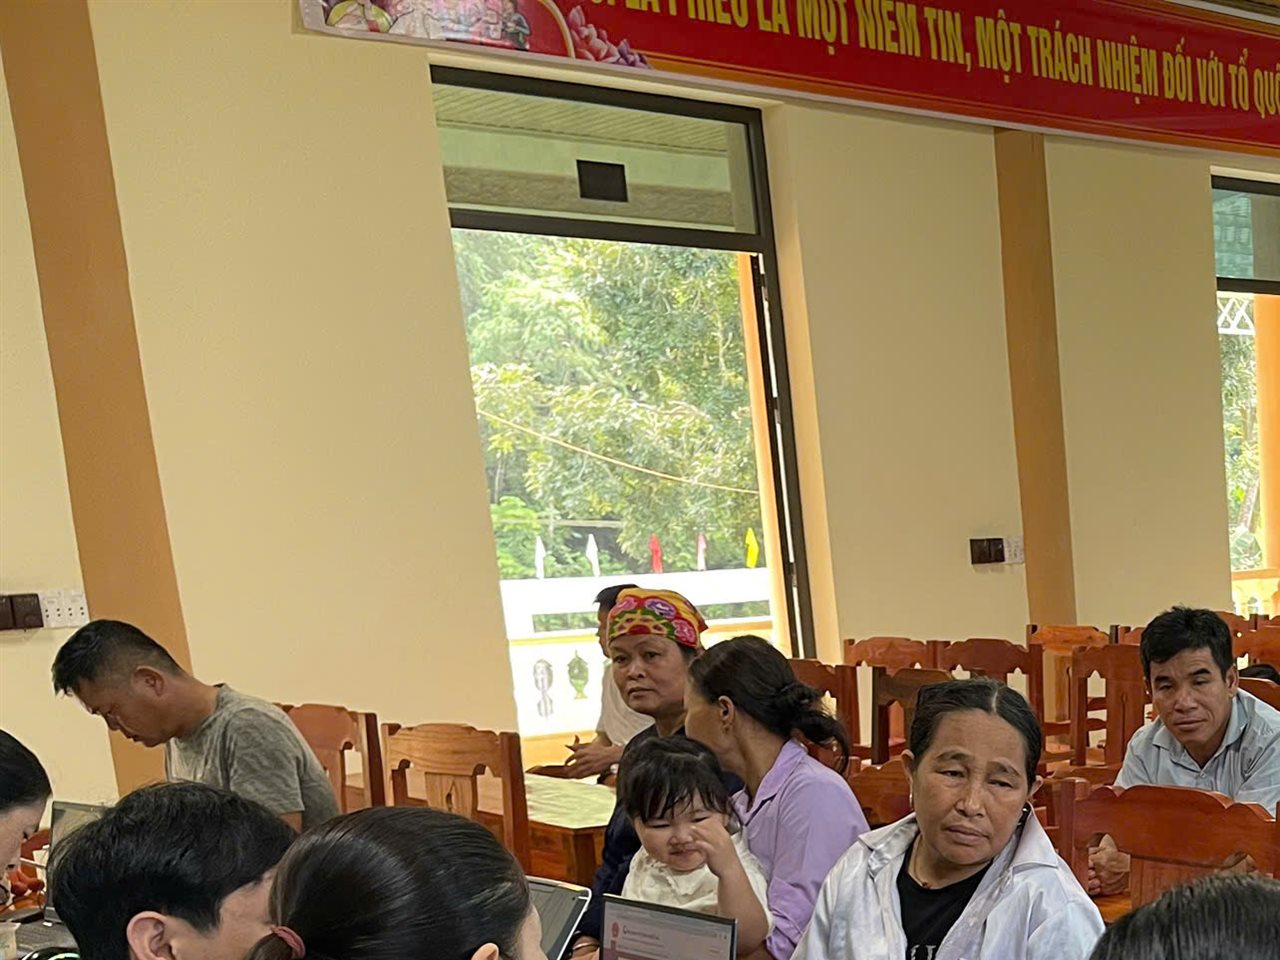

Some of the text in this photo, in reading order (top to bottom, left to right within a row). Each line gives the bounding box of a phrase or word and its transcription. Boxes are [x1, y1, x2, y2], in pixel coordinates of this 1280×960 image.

[924, 7, 971, 72] TIN,
[975, 9, 1022, 83] MỘT
[1027, 20, 1093, 86] TRÁCH
[1097, 35, 1159, 104] NHIỆM
[1163, 37, 1193, 102] ĐỐI
[1197, 50, 1226, 107] VỚI
[1228, 48, 1249, 111] TỔ
